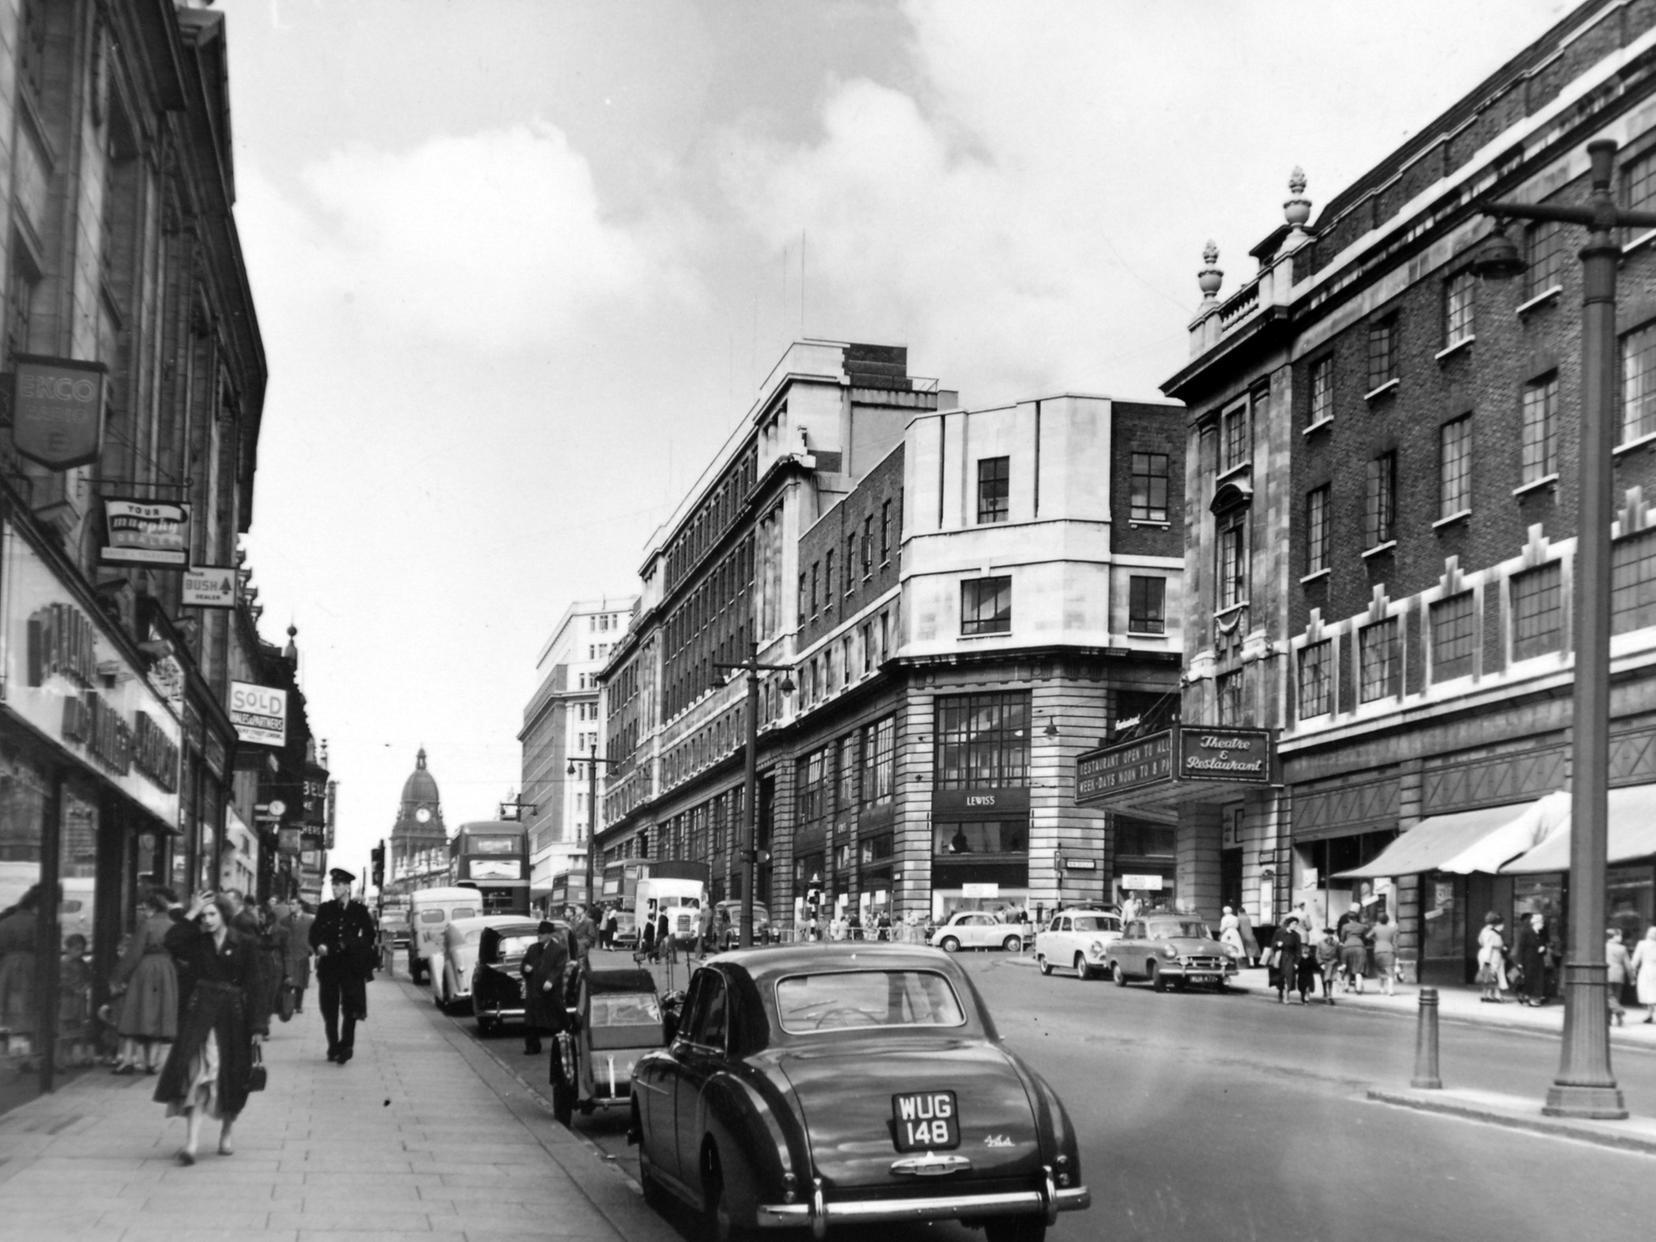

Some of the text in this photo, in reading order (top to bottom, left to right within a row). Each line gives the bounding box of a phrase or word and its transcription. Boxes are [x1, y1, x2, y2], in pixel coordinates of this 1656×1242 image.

[128, 505, 160, 516] YOUR
[185, 579, 219, 592] BUSH
[234, 690, 282, 715] SOLD
[1200, 735, 1250, 750] Theatre
[1080, 739, 1171, 775] RESTAURANT OPEN TO ALL
[1186, 756, 1262, 771] Restaurant
[1140, 764, 1149, 778] TO
[900, 1095, 951, 1120] WUG
[907, 1120, 949, 1145] 148
